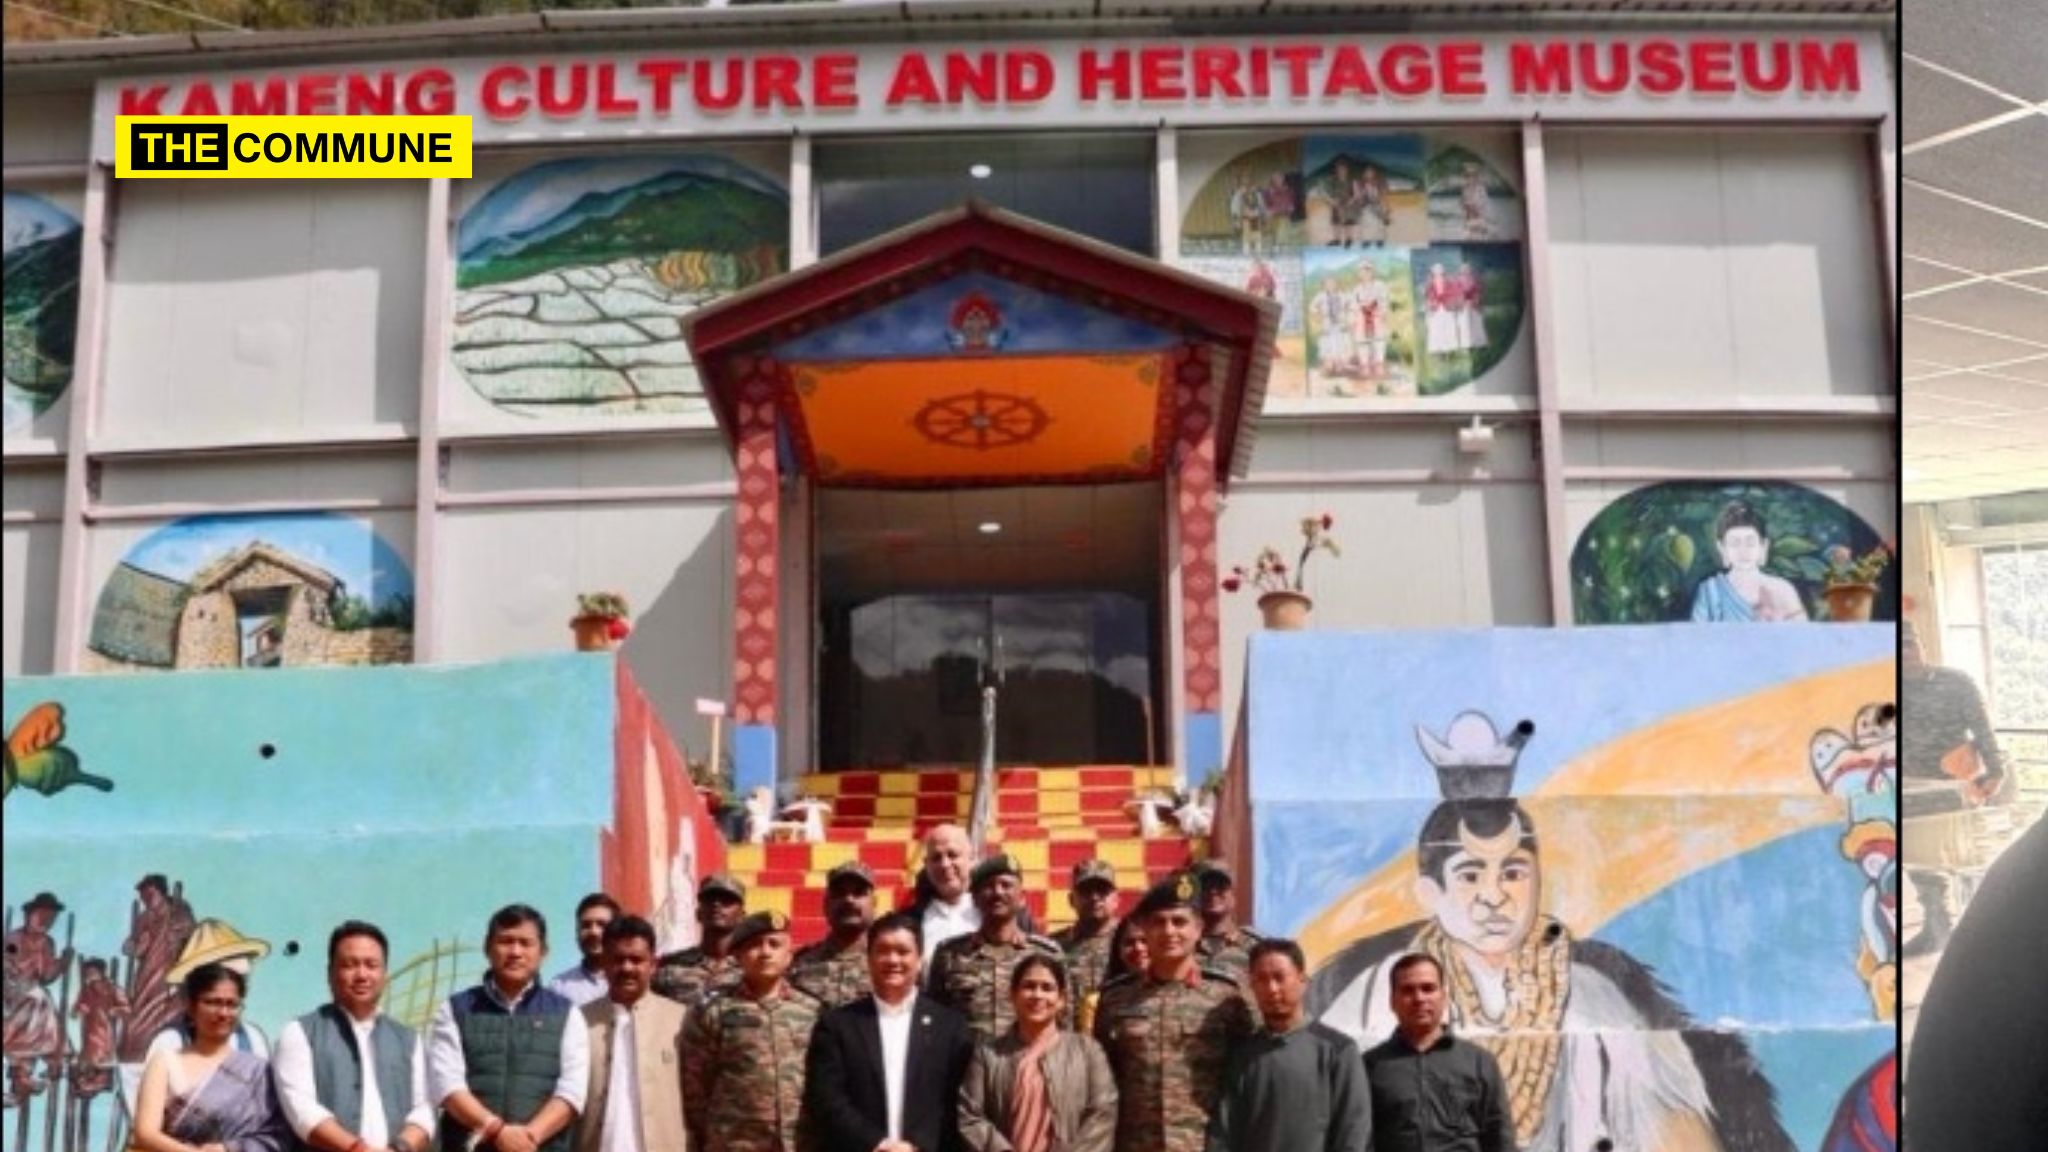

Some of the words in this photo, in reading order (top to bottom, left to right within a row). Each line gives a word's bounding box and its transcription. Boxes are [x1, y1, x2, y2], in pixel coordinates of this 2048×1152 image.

[117, 66, 456, 116] KAMENG
[479, 53, 857, 120] CULTURE
[884, 48, 1056, 104] AND
[1077, 40, 1487, 101] HERITAGE
[1508, 38, 1861, 94] MUSEUM
